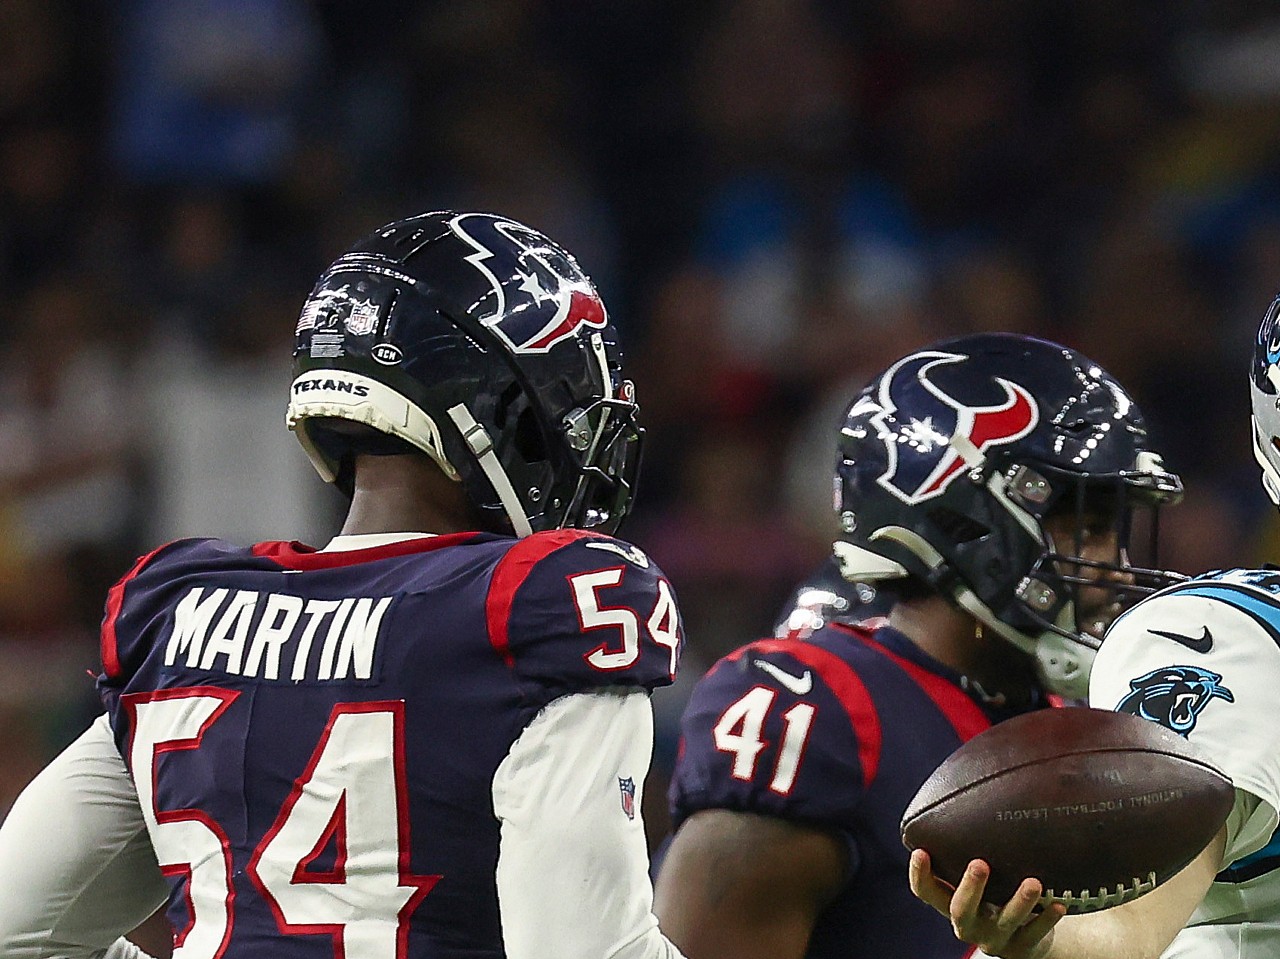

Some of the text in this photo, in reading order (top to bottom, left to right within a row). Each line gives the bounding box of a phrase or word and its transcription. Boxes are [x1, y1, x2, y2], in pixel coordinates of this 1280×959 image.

[294, 379, 370, 397] TEXANS
[164, 587, 392, 684] MARTIN
[565, 565, 680, 682] 54
[711, 684, 818, 796] 41
